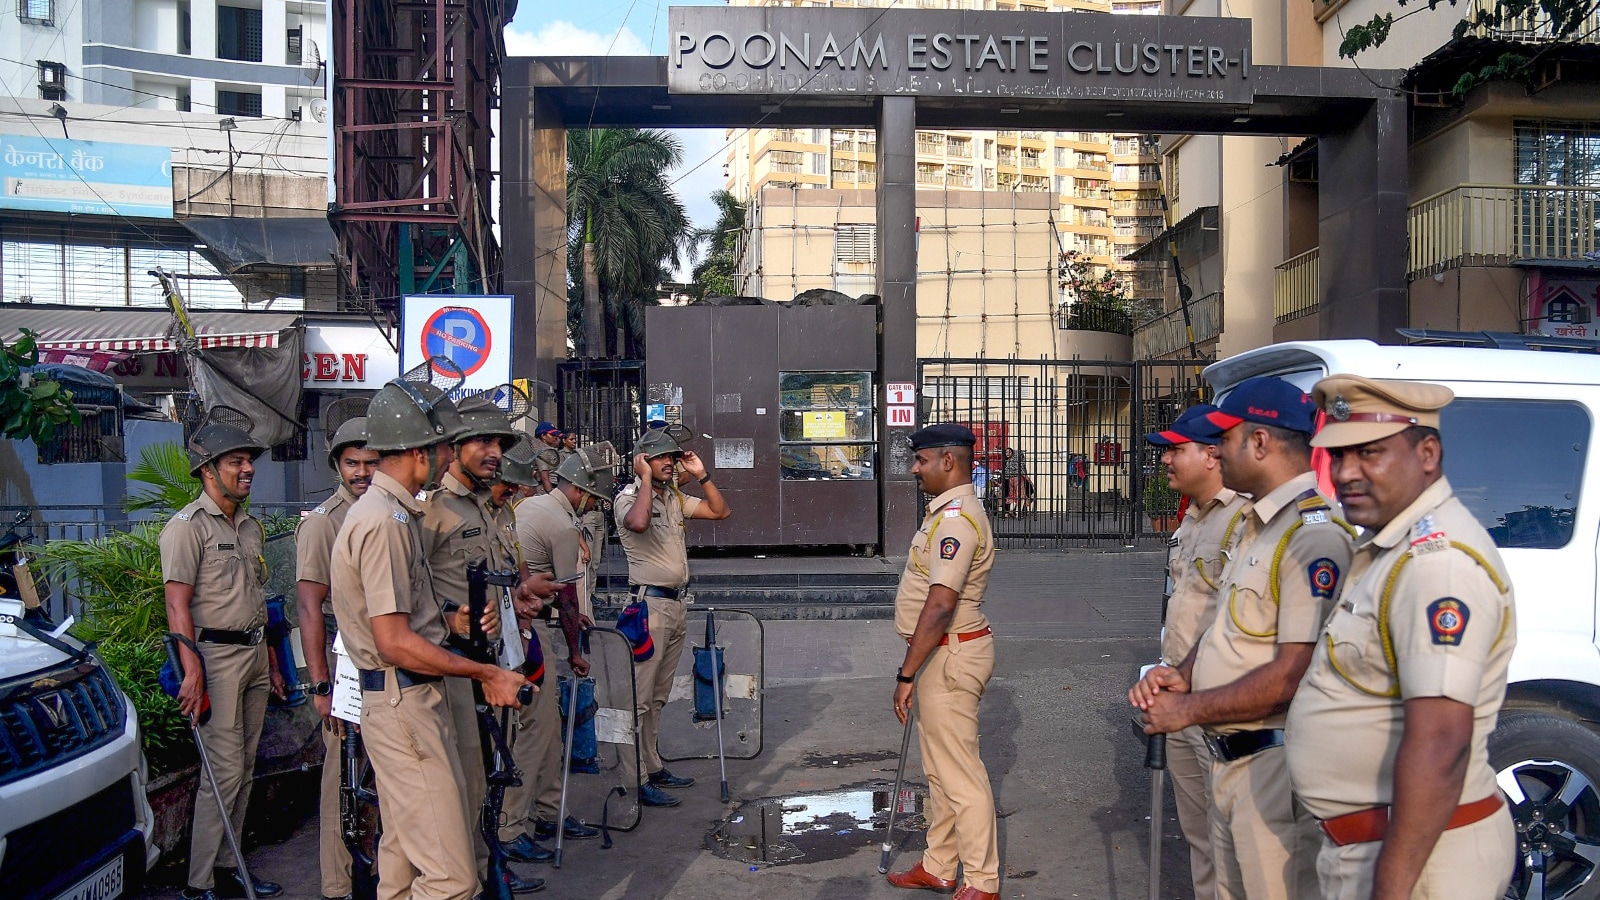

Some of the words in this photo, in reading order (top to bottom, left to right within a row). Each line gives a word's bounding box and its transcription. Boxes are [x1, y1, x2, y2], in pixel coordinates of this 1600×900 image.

[675, 31, 888, 70] POONAM
[908, 33, 1049, 71] ESTATE
[1067, 41, 1248, 78] CLUSTER-I
[4, 144, 65, 170] केनरा
[70, 149, 104, 172] बैंक
[119, 189, 170, 202] Syndicate
[1554, 324, 1587, 338] खरेदी
[436, 330, 447, 339] NO
[447, 335, 479, 352] PARKING
[894, 391, 903, 402] 1
[892, 409, 911, 423] IN
